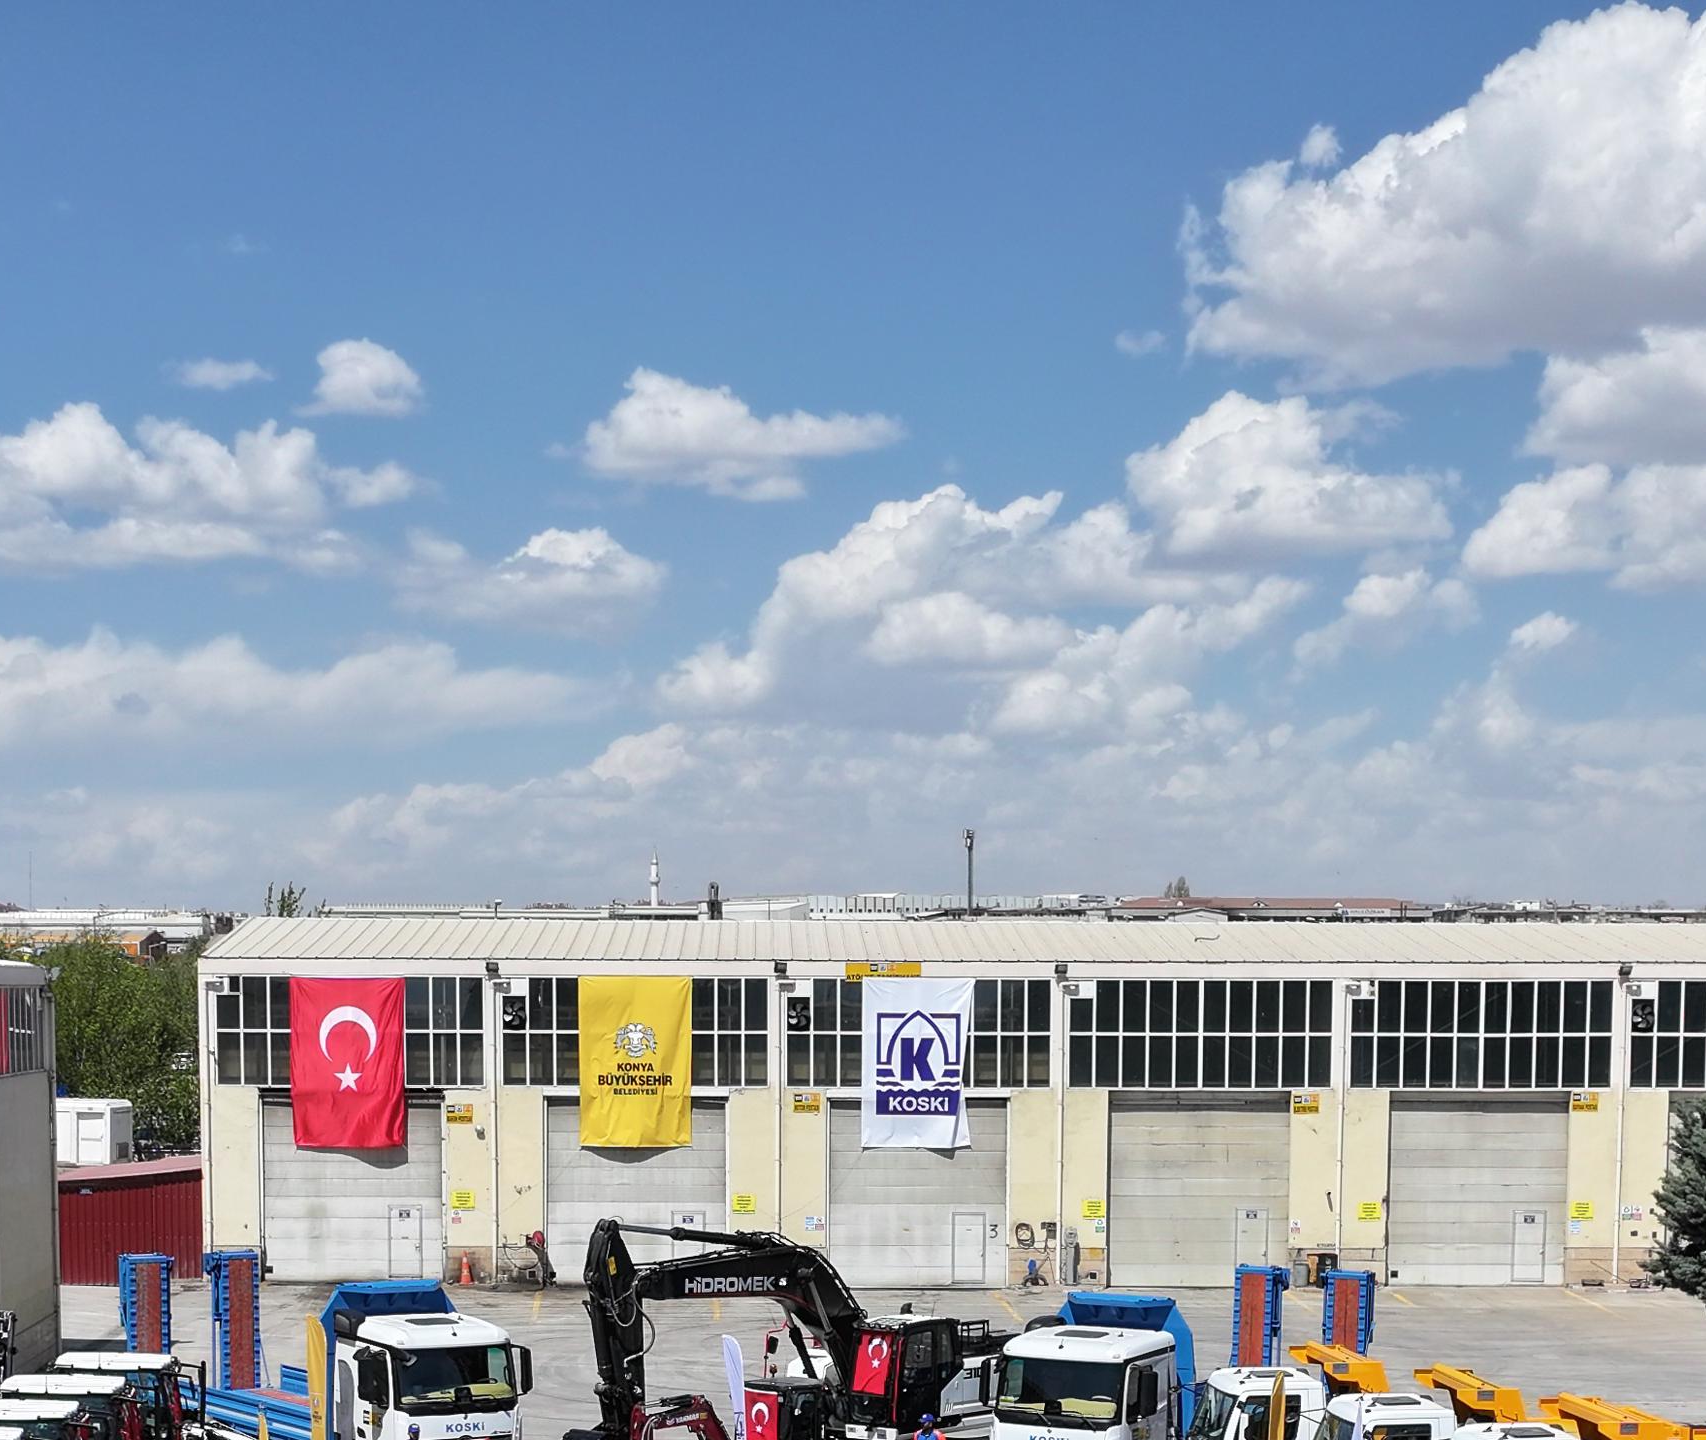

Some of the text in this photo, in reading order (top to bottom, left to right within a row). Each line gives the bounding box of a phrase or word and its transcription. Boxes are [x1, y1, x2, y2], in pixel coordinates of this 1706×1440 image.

[900, 1037, 936, 1081] K
[617, 1062, 654, 1072] KONYA
[613, 1087, 658, 1095] BELEDİYESİ
[989, 1224, 998, 1239] 3
